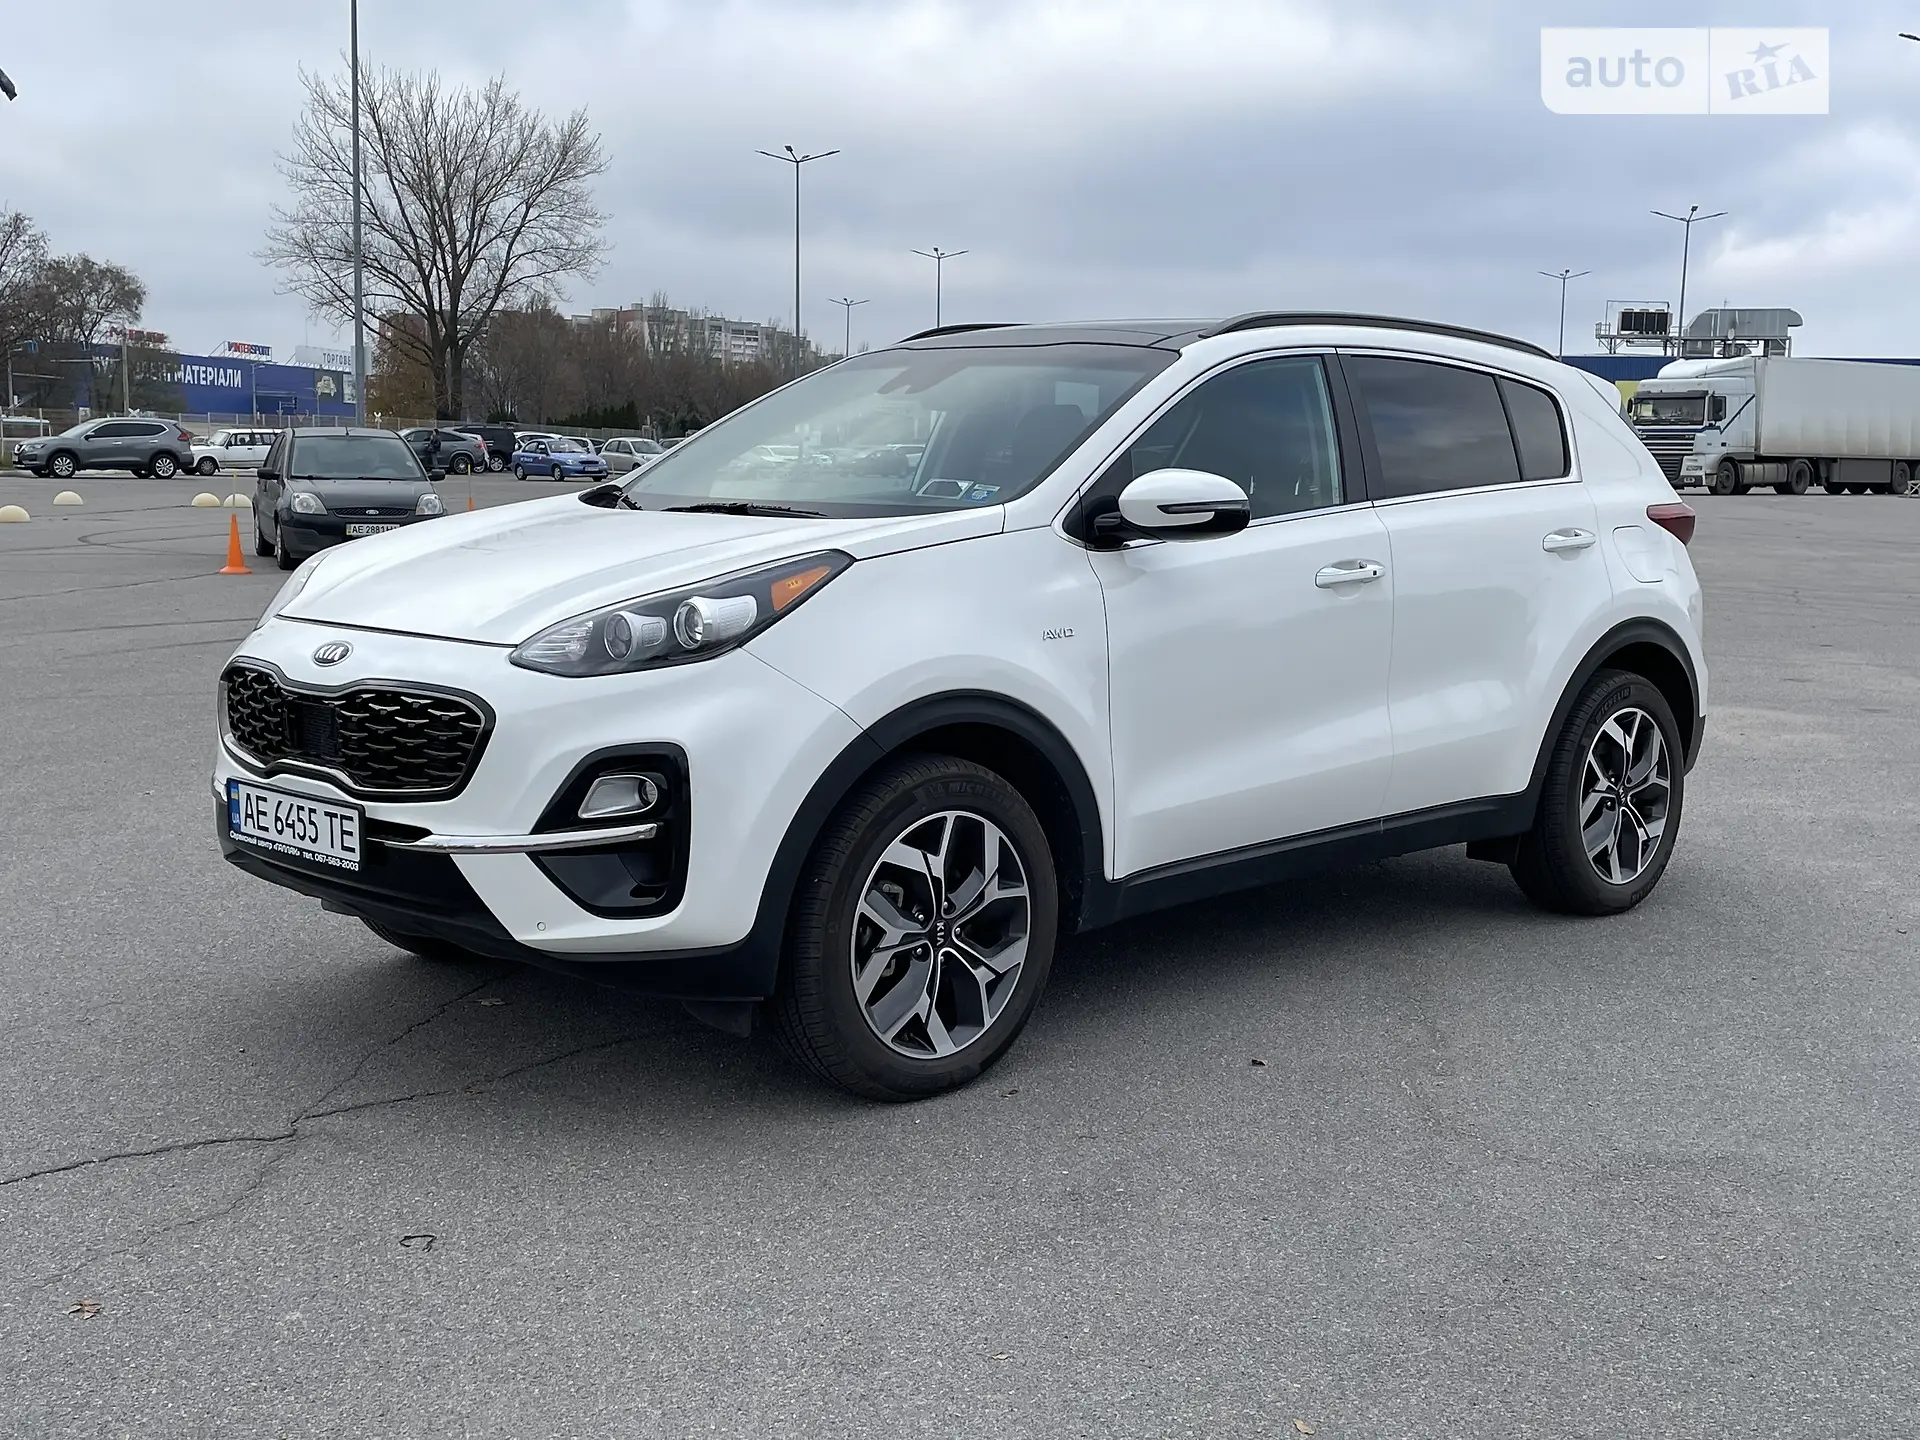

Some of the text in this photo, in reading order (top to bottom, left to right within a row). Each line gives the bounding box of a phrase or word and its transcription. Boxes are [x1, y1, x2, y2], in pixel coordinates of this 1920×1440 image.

[174, 363, 242, 389] МАТЕРІАЛИ
[352, 526, 364, 534] AE
[1042, 628, 1074, 641] AWD
[314, 644, 345, 661] KIA
[231, 812, 240, 824] UA
[244, 792, 356, 854] AE 6455 TE
[936, 921, 944, 946] KIA
